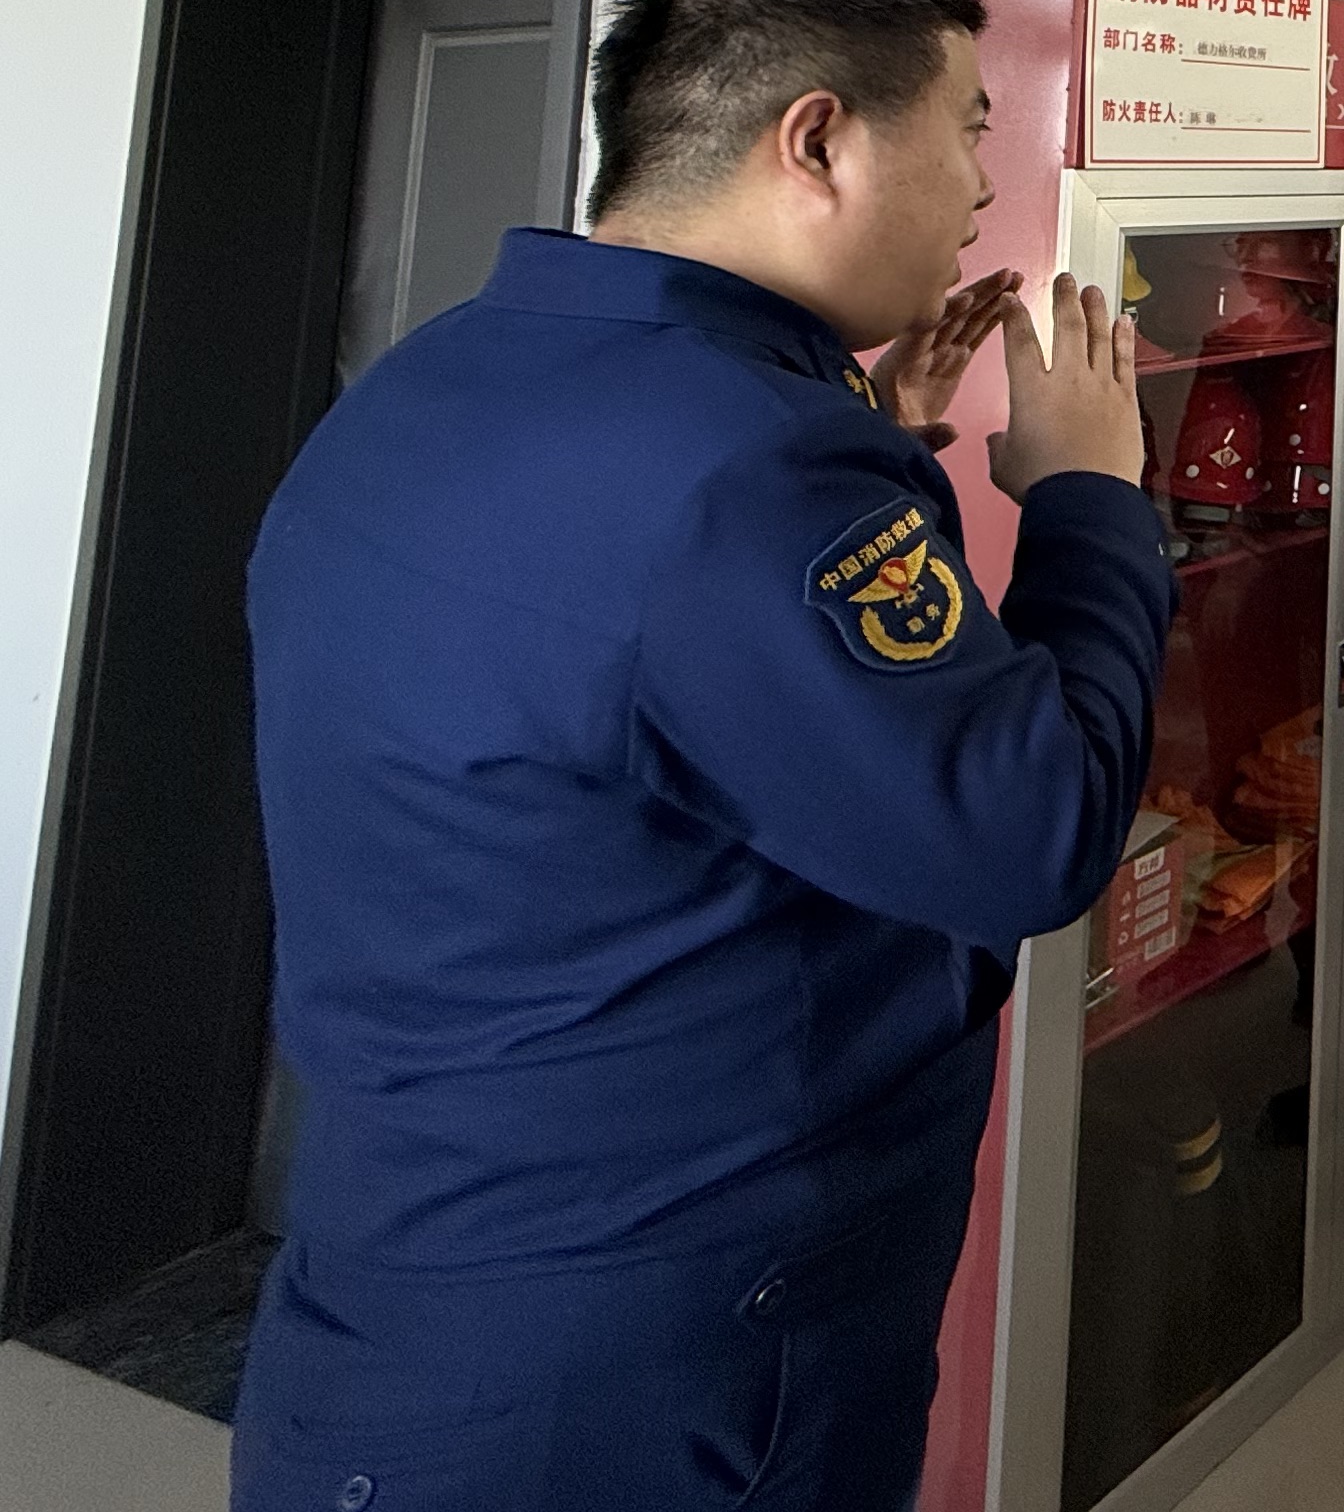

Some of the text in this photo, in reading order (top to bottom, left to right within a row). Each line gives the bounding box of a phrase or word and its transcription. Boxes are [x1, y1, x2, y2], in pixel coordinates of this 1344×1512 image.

[819, 508, 925, 591] 中国消防救援
